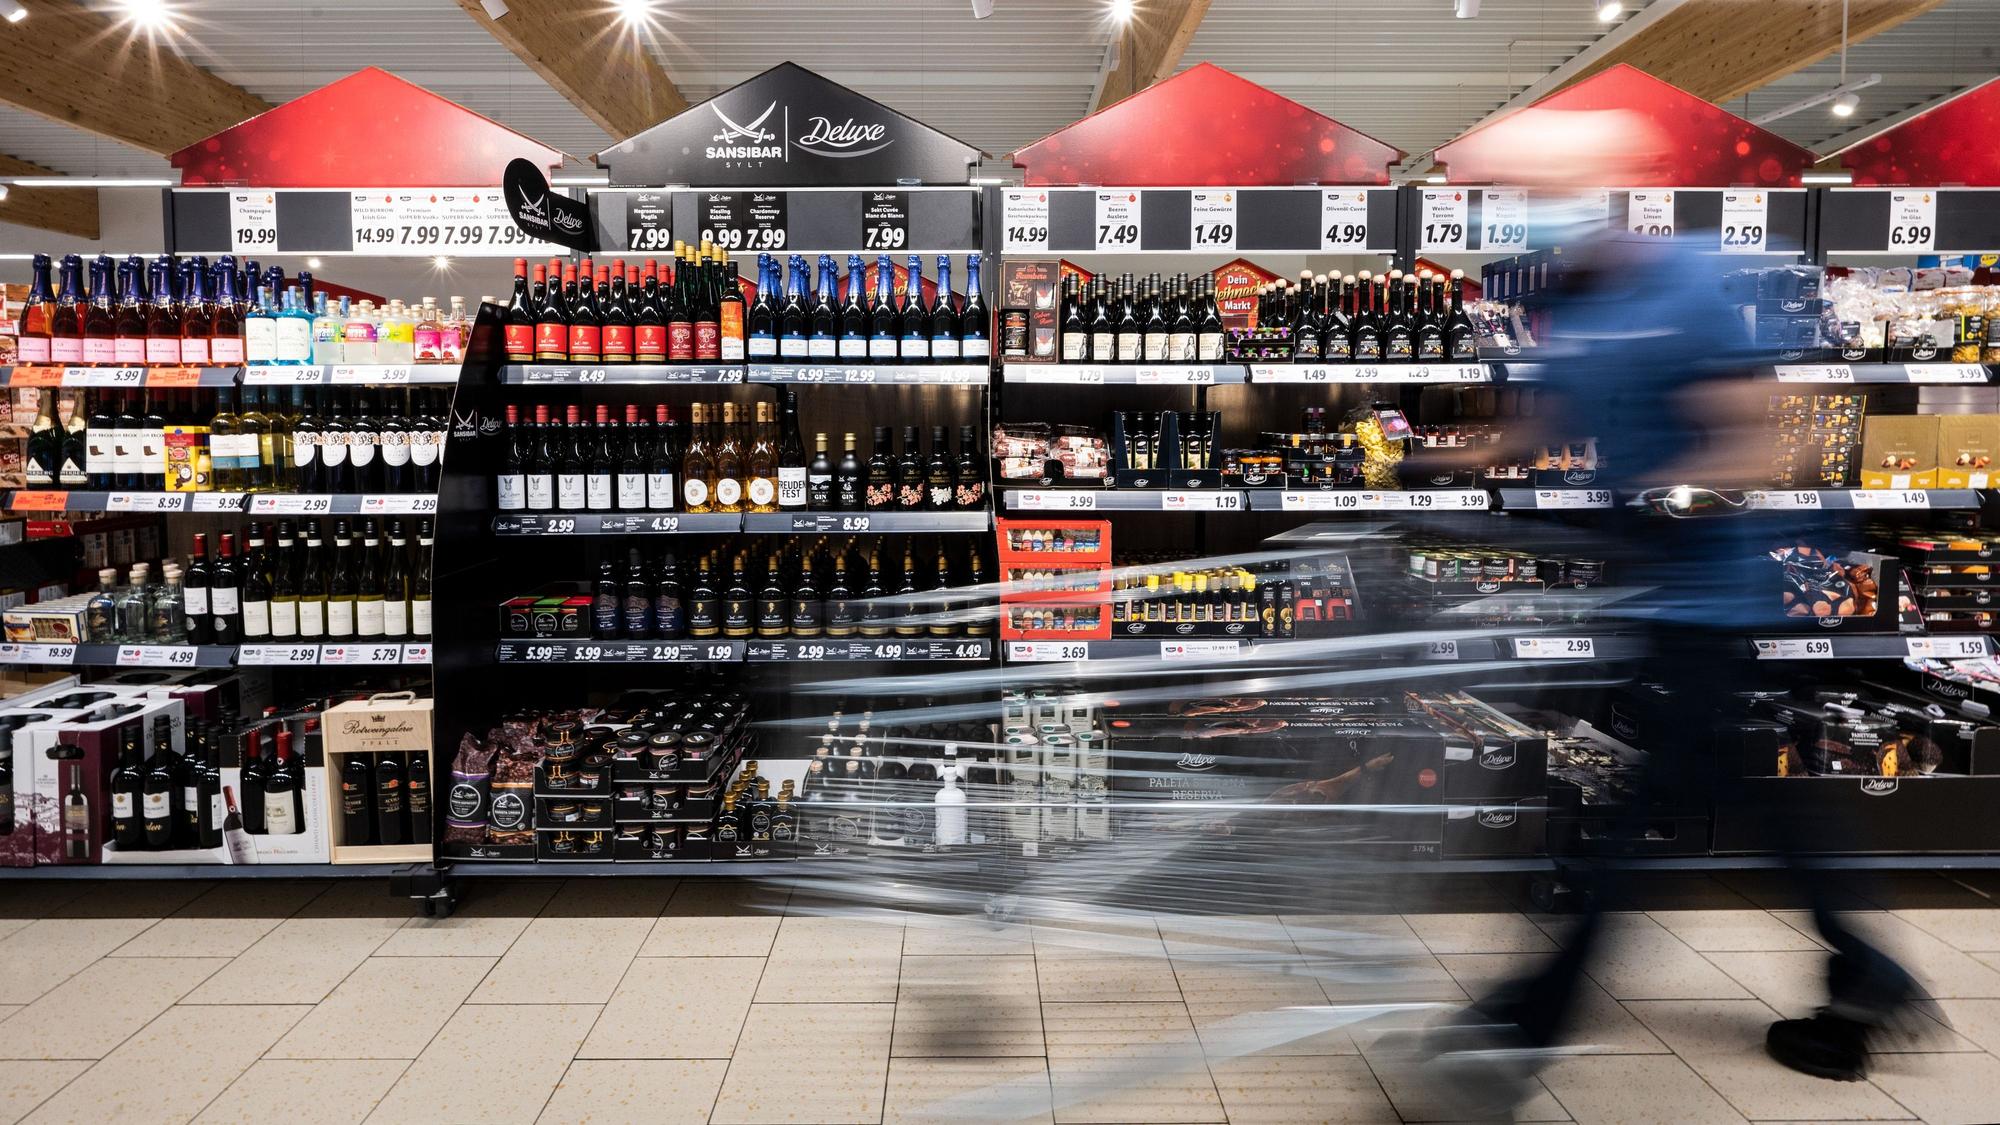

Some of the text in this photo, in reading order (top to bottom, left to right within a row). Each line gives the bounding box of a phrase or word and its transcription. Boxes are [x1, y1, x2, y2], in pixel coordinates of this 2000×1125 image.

[799, 116, 885, 148] Deluxe
[705, 147, 782, 159] SANSIBAR
[518, 211, 549, 227] SANSIBAR
[553, 208, 583, 229] Deluxe
[236, 229, 276, 244] 19.99
[355, 228, 395, 243] 14.99
[401, 226, 439, 244] 7.99
[444, 226, 483, 244] 7.99
[488, 226, 526, 244] 7.99
[631, 229, 670, 249] 7.99
[747, 229, 786, 249] 7.99
[866, 228, 905, 248] 7.99
[1008, 227, 1048, 243] 14.99
[1099, 224, 1138, 244] 7.49
[1195, 224, 1233, 244] 1.49
[1326, 224, 1367, 243] 4.99
[1425, 224, 1463, 243] 1.79
[1487, 224, 1526, 243] 1.99
[1723, 226, 1763, 245] 2.59
[1891, 226, 1931, 245] 6.99
[1227, 275, 1248, 285] Dein
[1224, 301, 1251, 310] Markt
[113, 371, 139, 381] 5.99
[296, 370, 320, 381] 2.99
[382, 369, 407, 380] 3.99
[579, 370, 606, 382] 8.49
[717, 370, 743, 382] 7.99
[797, 368, 823, 381] 6.99
[845, 369, 876, 381] 12.99
[940, 369, 971, 382] 14.99
[1078, 370, 1102, 381] 1.79
[1187, 370, 1211, 381] 2.99
[1303, 369, 1327, 380] 1.49
[1354, 368, 1378, 379] 2.99
[1458, 369, 1480, 379] 1.19
[1826, 368, 1850, 379] 3.99
[1957, 368, 1982, 379] 3.99
[453, 430, 477, 438] SANSIBAR
[1567, 471, 1592, 481] Deluxe
[782, 489, 801, 498] FEST
[1586, 491, 1610, 503] 3.99
[1794, 493, 1817, 504] 1.99
[1902, 492, 1925, 504] 1.49
[158, 498, 182, 508] 8.99
[218, 498, 241, 509] 9.99
[303, 500, 328, 511] 2.99
[412, 500, 436, 511] 2.99
[1069, 496, 1093, 507] 3.99
[1215, 496, 1237, 508] 1.19
[1334, 495, 1357, 507] 1.09
[1409, 495, 1432, 507] 1.29
[1461, 495, 1484, 507] 3.99
[548, 519, 575, 533] 2.99
[651, 517, 678, 530] 4.99
[842, 517, 870, 531] 8.99
[798, 645, 824, 659] 2.99
[875, 645, 902, 659] 4.99
[955, 644, 982, 657] 4.49
[1431, 642, 1455, 654] 2.99
[1567, 640, 1591, 652] 2.99
[1806, 641, 1829, 654] 6.99
[1959, 642, 1982, 654] 1.59
[48, 647, 73, 658] 19.99
[169, 652, 194, 663] 4.99
[290, 649, 315, 661] 2.99
[372, 649, 397, 661] 5.79
[526, 647, 552, 660] 5.99
[574, 647, 601, 660] 5.99
[652, 646, 680, 660] 2.99
[707, 646, 732, 659] 1.99
[1062, 647, 1086, 658] 3.69
[1929, 680, 1969, 698] Deluxe
[342, 720, 414, 737] Rotweingalerie
[1176, 752, 1216, 767] Deluxe
[1483, 754, 1513, 764] Deluxe
[1149, 777, 1189, 788] PALETA
[1865, 779, 1895, 790] Deluxe
[1172, 790, 1224, 800] RESERVA
[1483, 813, 1513, 823] Deluxe
